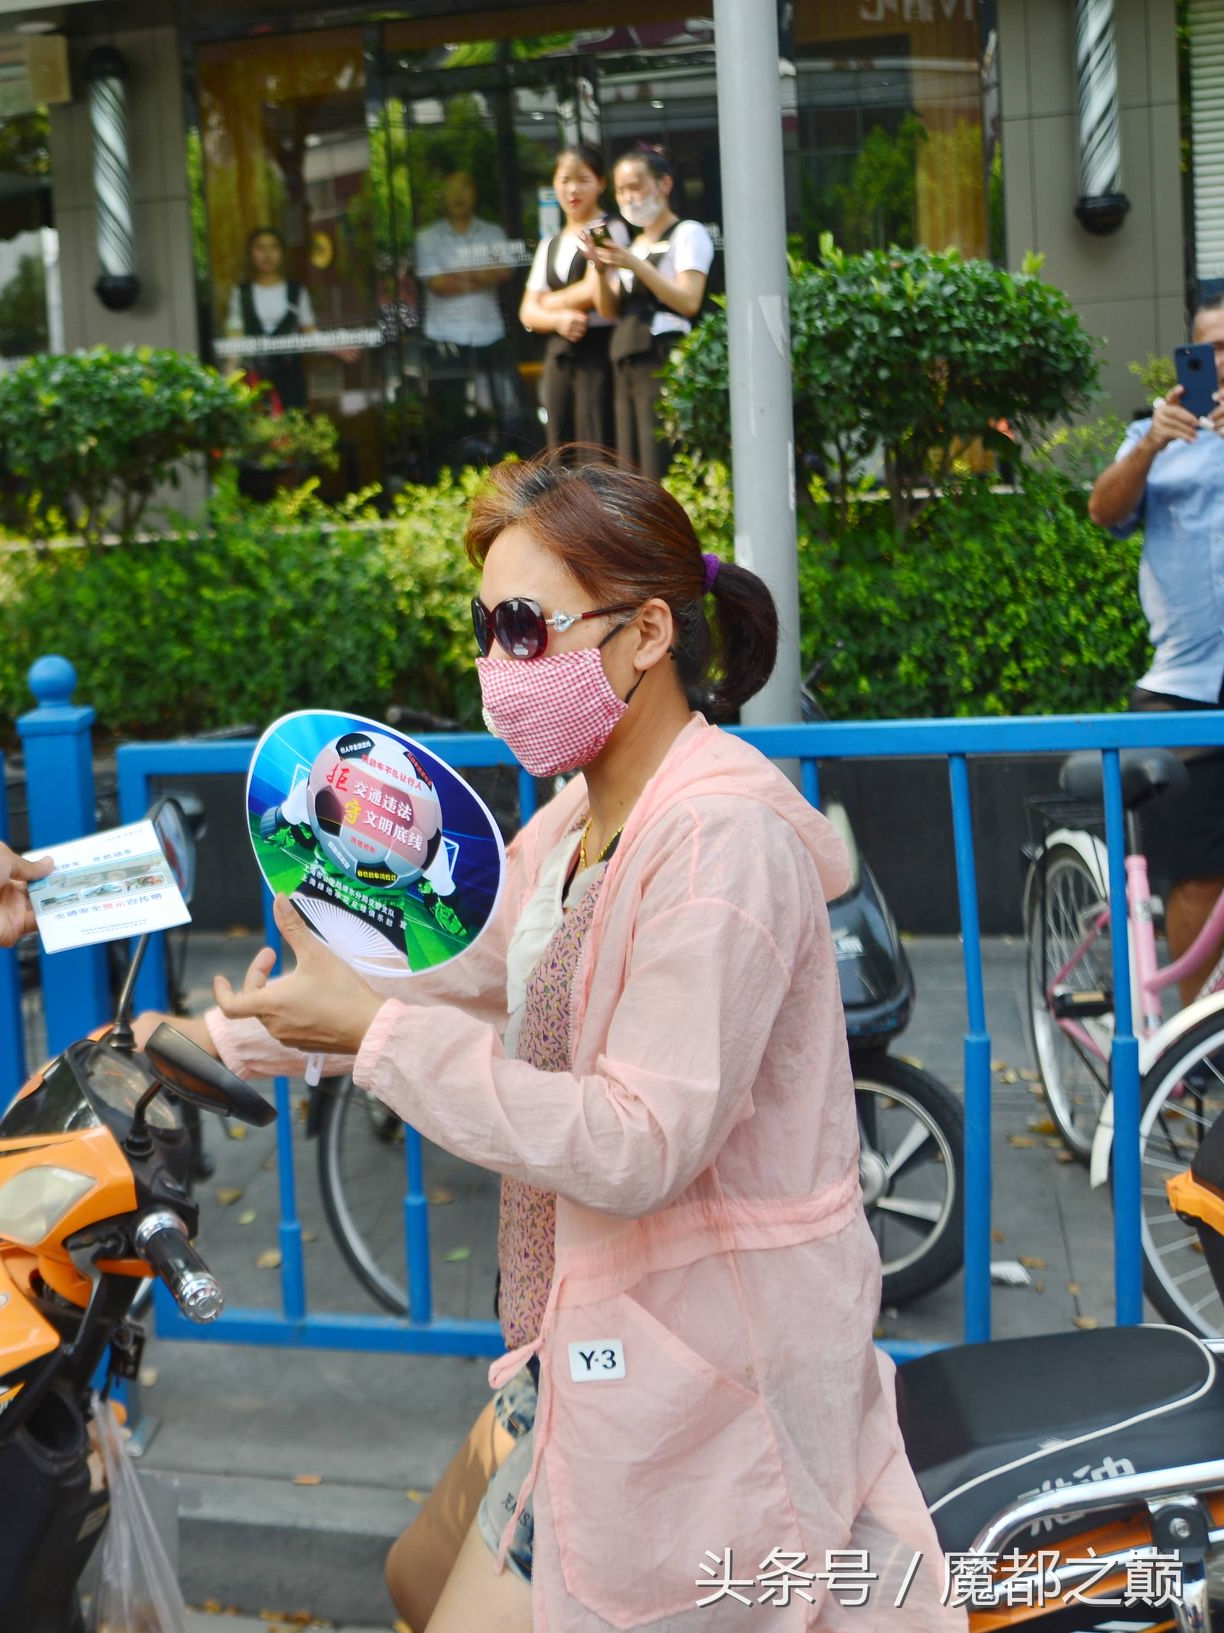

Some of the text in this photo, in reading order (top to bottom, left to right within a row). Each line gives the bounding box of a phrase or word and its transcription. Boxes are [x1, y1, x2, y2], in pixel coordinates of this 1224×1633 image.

[325, 763, 413, 822] 拒 交通违法
[362, 808, 424, 852] 文明底线
[578, 1349, 617, 1371] Y-3
